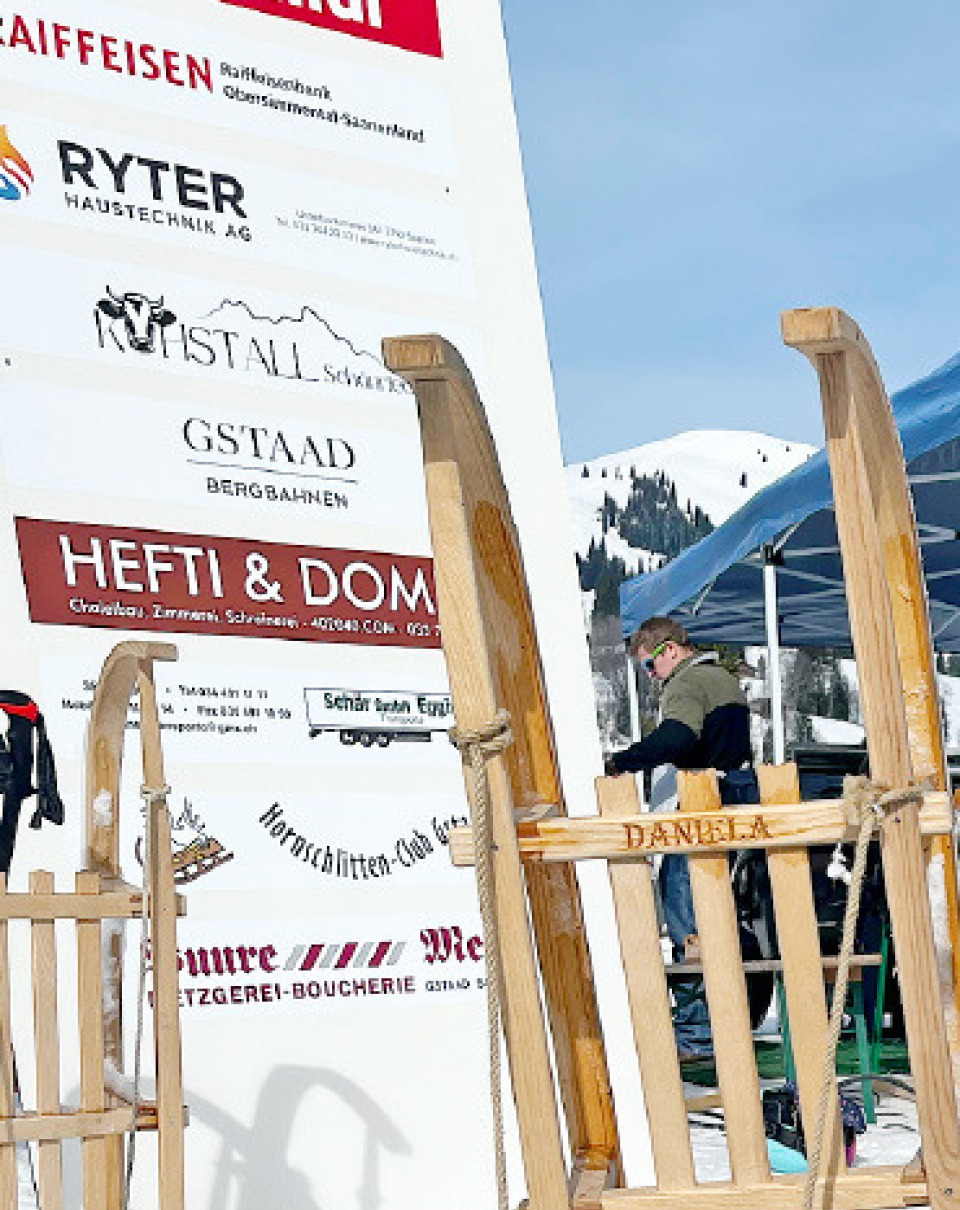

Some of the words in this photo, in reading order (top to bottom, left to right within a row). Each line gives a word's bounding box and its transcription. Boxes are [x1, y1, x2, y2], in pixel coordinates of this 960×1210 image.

[0, 13, 214, 93] AIFFEISEN
[220, 61, 332, 101] Raiffeisenbank
[57, 140, 247, 218] RYTER
[64, 192, 216, 235] HAUSTECHNIK
[225, 223, 252, 242] AG
[183, 417, 357, 470] GSTAAD
[206, 476, 349, 509] BERGBAHNEN
[58, 534, 224, 598] HEFTI
[244, 552, 284, 603] &
[298, 557, 437, 616] DOM
[324, 692, 370, 712] Schär
[258, 802, 434, 880] Hornschlitten-Club
[623, 815, 774, 850] DANIELA
[147, 975, 417, 1010] ETZGEREI-BOUCHERIE
